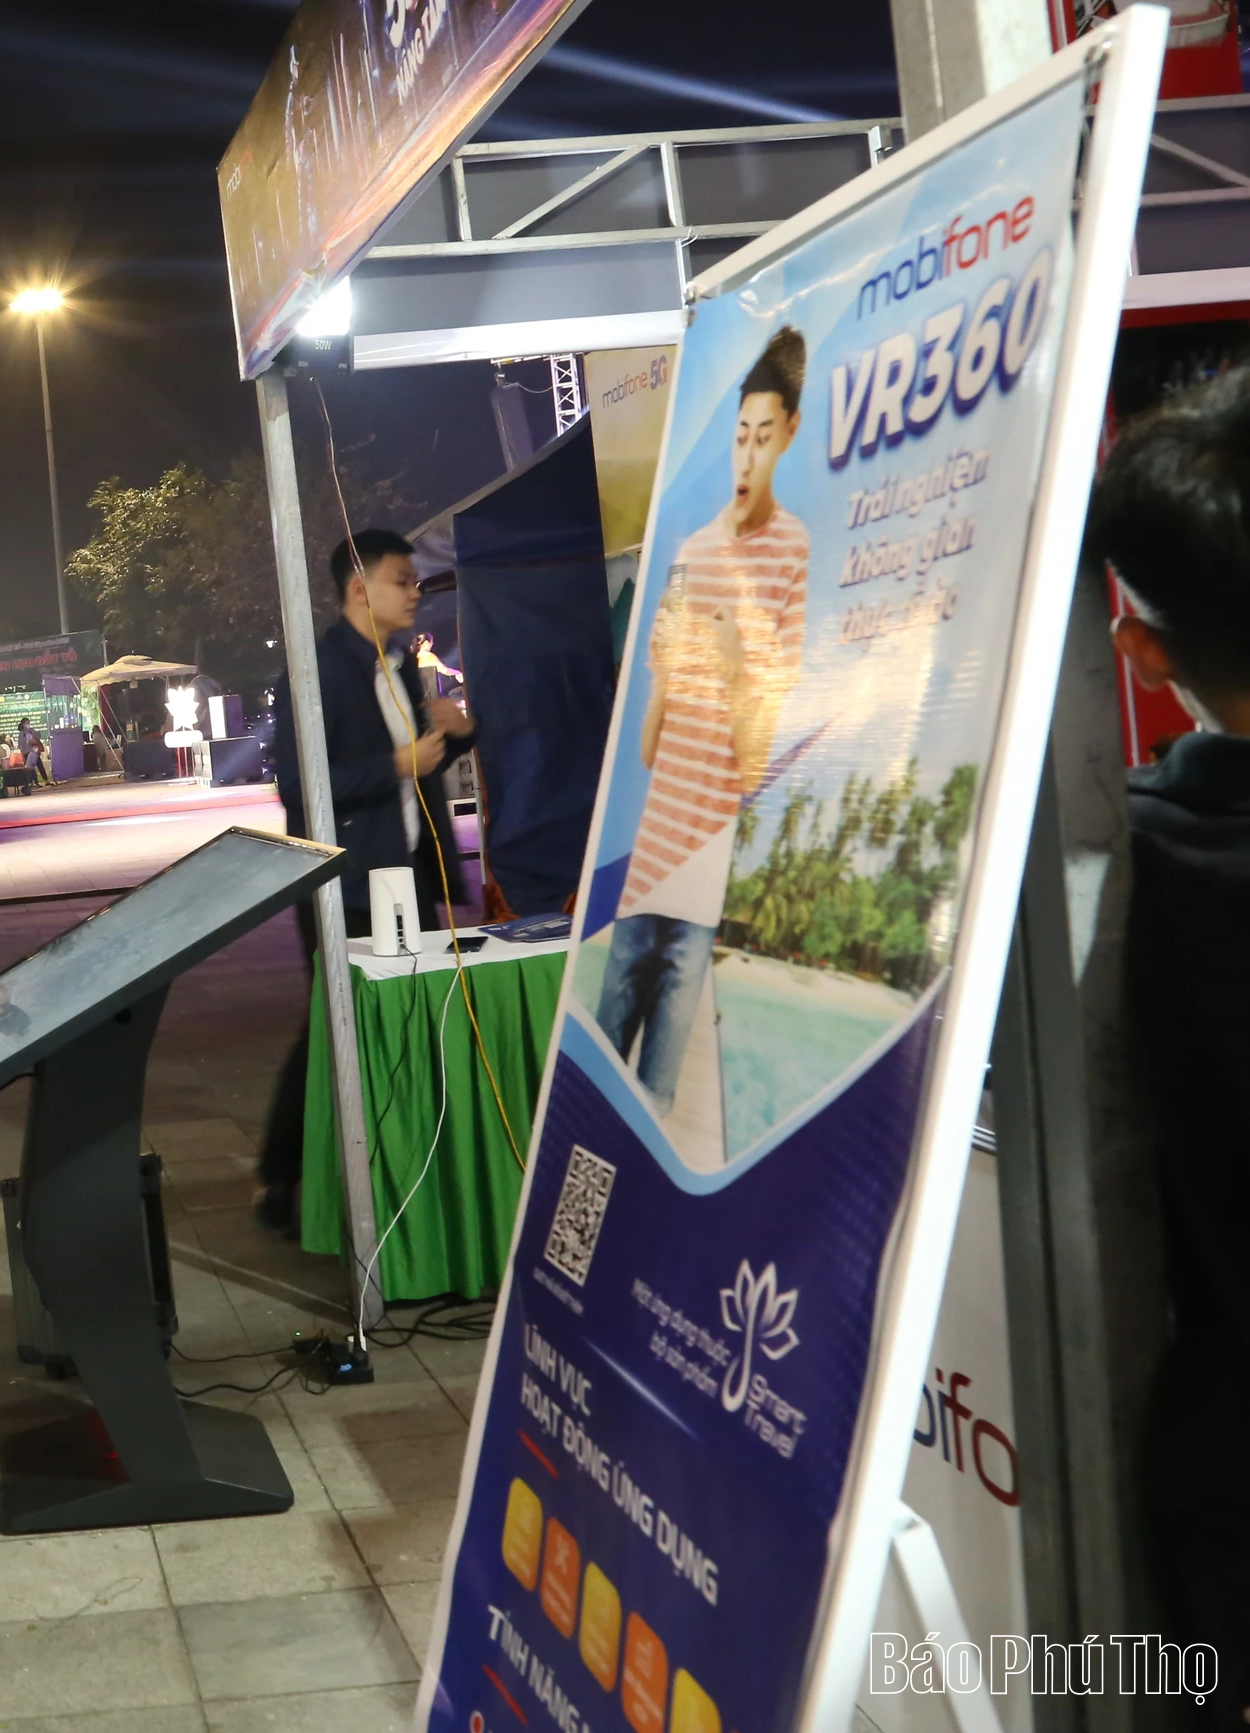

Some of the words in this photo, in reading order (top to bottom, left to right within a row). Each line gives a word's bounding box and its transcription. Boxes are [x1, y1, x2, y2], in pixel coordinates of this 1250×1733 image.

[857, 195, 1036, 321] mobifone
[314, 340, 332, 350] 50W
[829, 246, 1052, 470] VR360
[602, 371, 648, 408] mobifone
[650, 355, 669, 390] 5G
[744, 1398, 799, 1460] Travel
[750, 1374, 807, 1435] Smart
[521, 1372, 563, 1438] HOẠT
[561, 1415, 611, 1493] ĐỘNG
[612, 1461, 655, 1539] ỨNG
[655, 1510, 719, 1607] DỤNG
[488, 1604, 530, 1678] TÍNH
